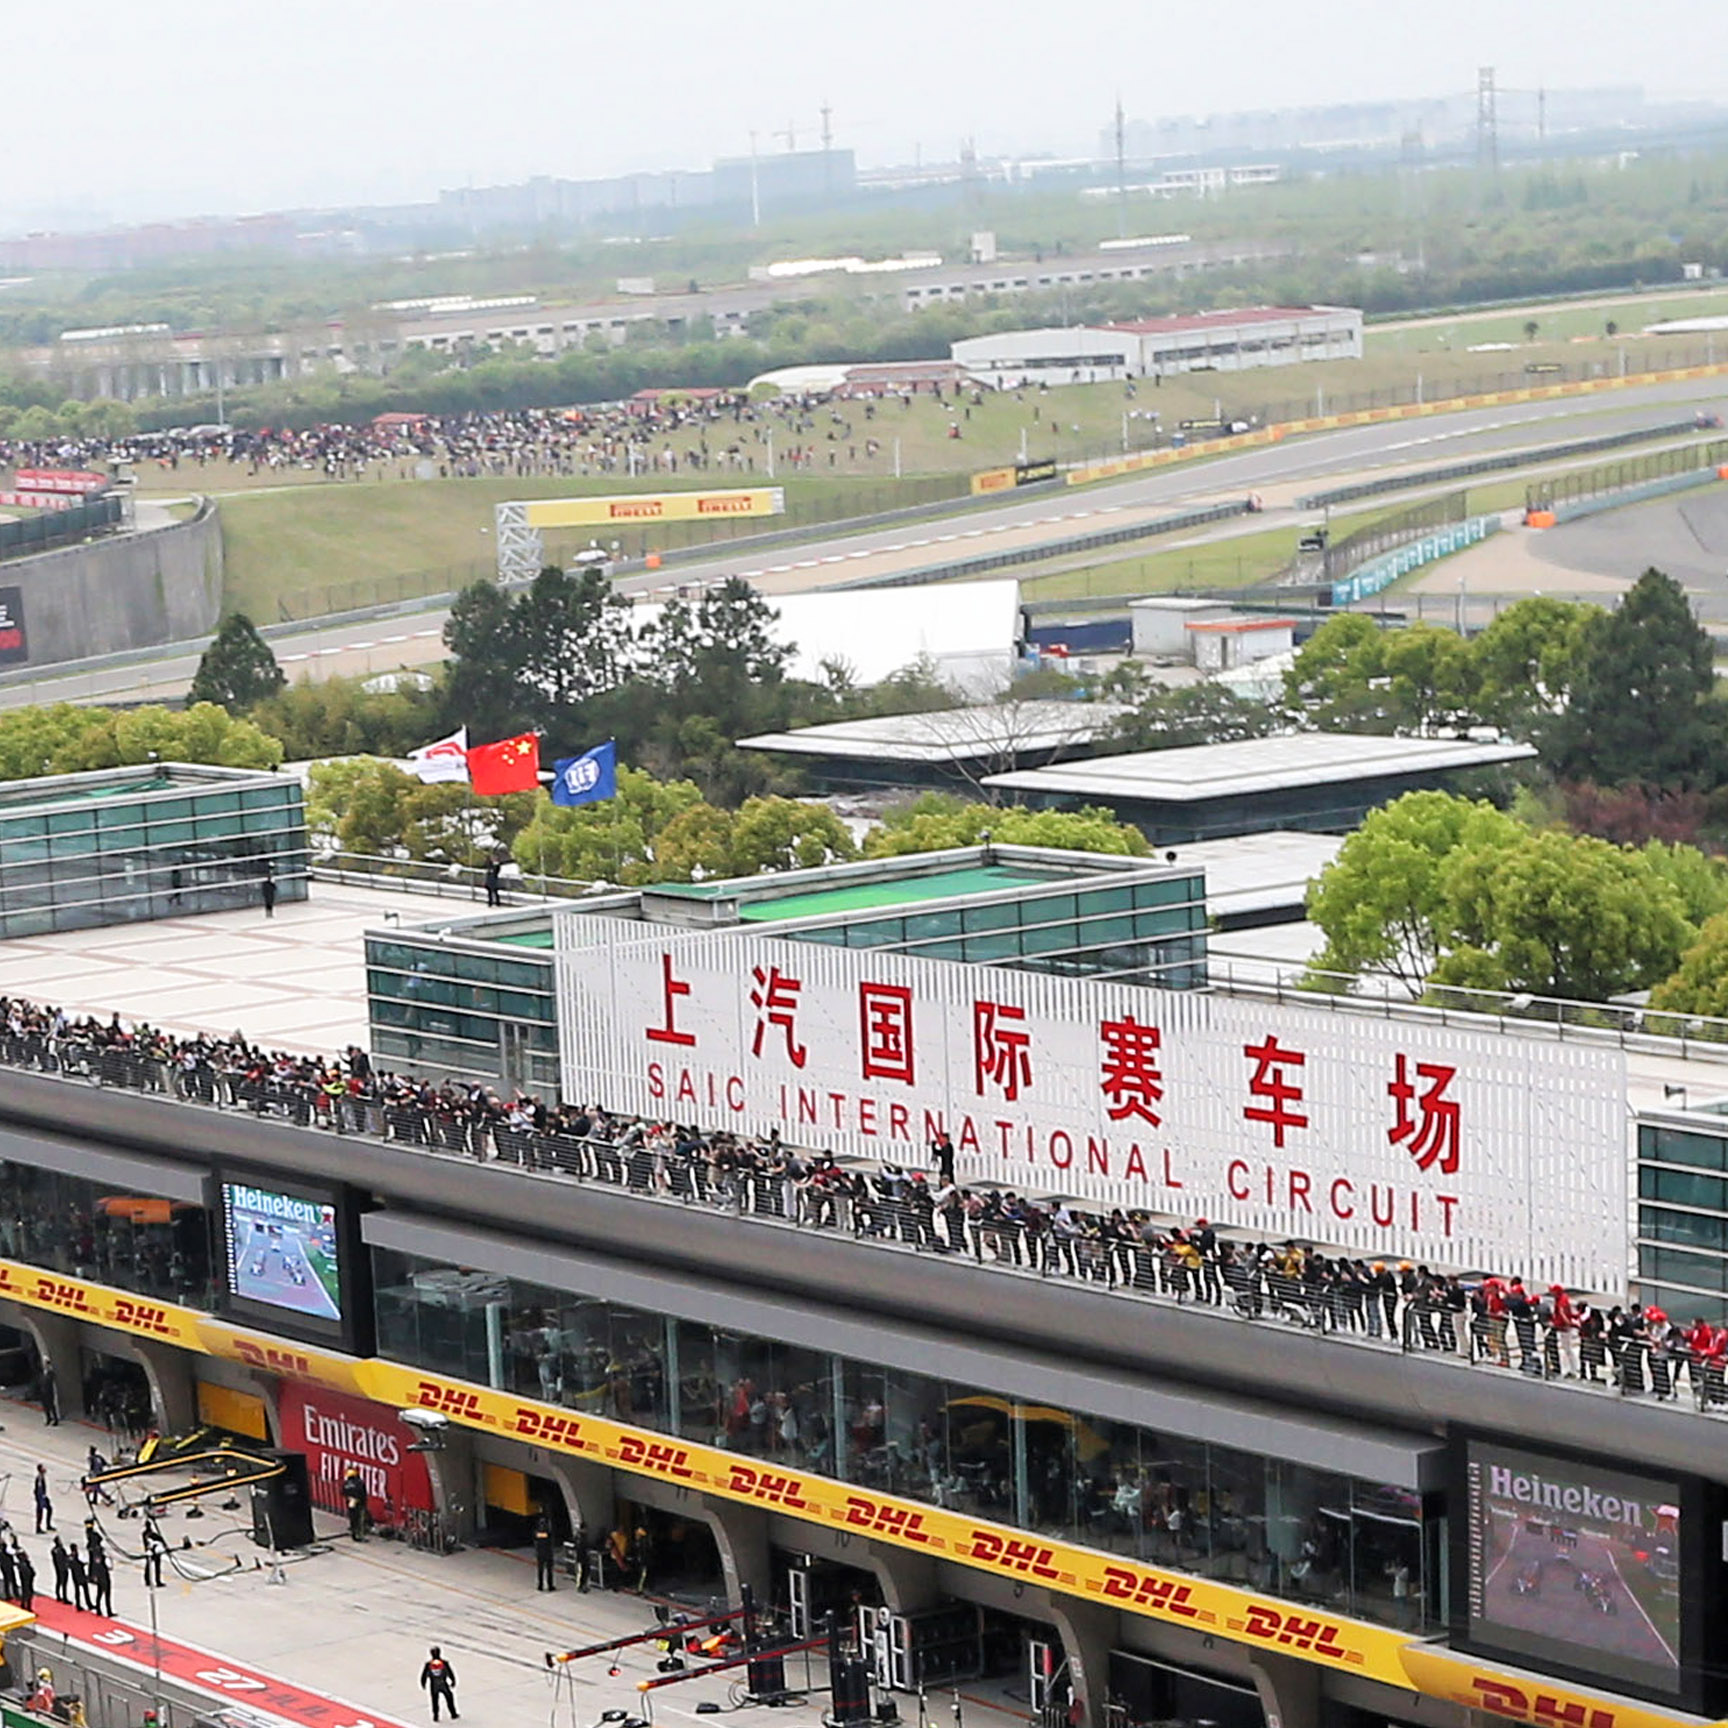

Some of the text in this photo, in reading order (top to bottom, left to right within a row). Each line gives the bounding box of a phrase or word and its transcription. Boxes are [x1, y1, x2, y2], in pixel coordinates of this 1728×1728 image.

[645, 953, 1461, 1175] 上汽国际赛车场
[648, 1060, 1459, 1239] SAIC INTERNATIONAL CIRCUIT
[233, 1185, 317, 1224] Heineken
[36, 1279, 91, 1313] DHL
[114, 1300, 170, 1334] DHL
[418, 1382, 483, 1420] DHL
[304, 1405, 400, 1466] Emirates
[515, 1408, 586, 1449] DHL
[619, 1435, 693, 1478] DHL
[729, 1464, 807, 1511] DHL
[1490, 1465, 1643, 1528] Heineken
[846, 1497, 933, 1543] DHL
[969, 1531, 1060, 1580] DHL
[1101, 1567, 1200, 1618] DHL
[92, 1629, 134, 1645] 3
[1244, 1605, 1346, 1660] DHL
[196, 1667, 267, 1690] 27
